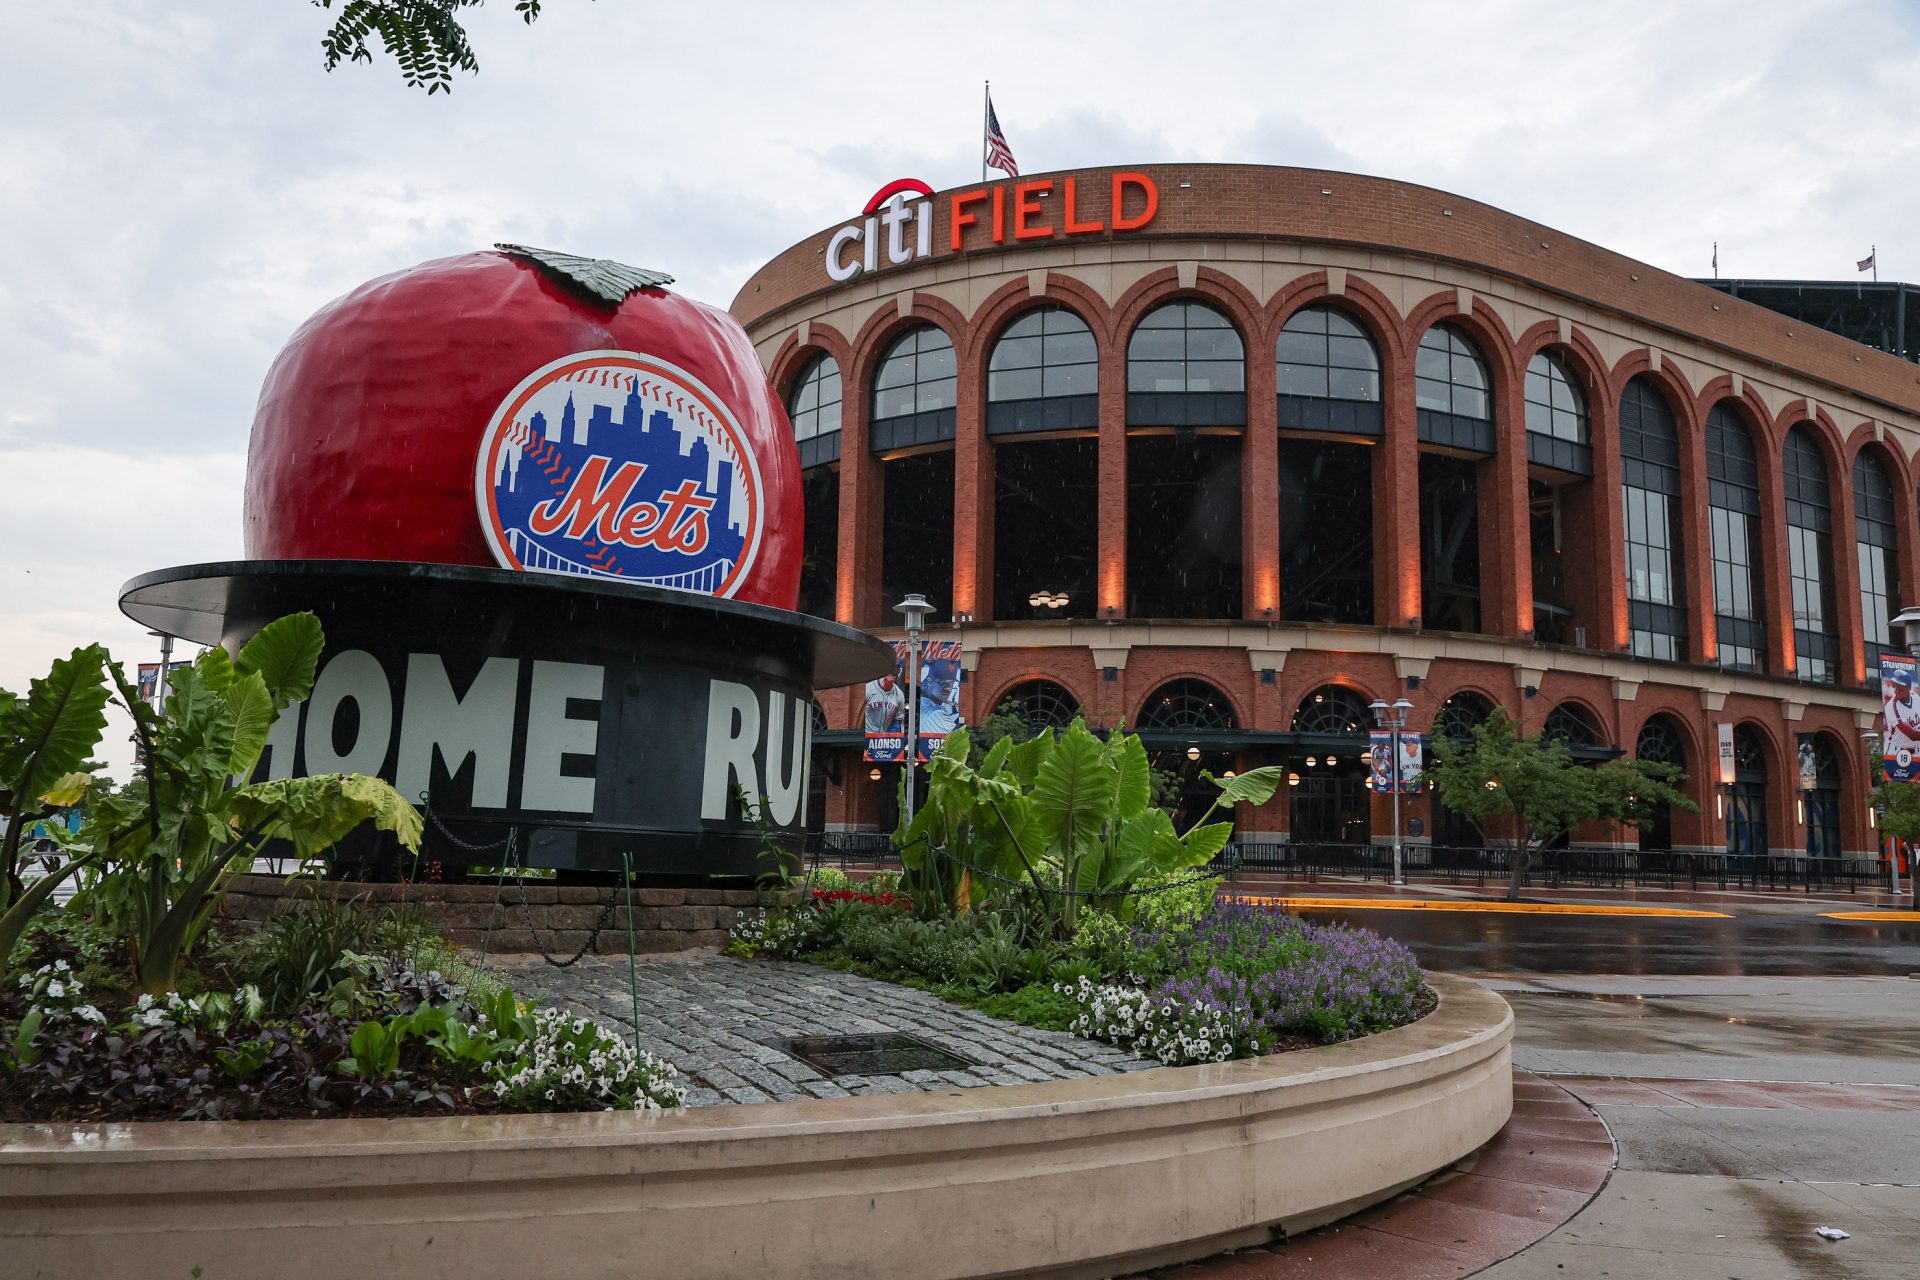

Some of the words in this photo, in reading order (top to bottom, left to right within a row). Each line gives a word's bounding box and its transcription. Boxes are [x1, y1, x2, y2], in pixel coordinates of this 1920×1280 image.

[826, 195, 932, 281] citi
[951, 172, 1159, 251] FIELD
[529, 454, 717, 556] Mets
[868, 738, 902, 749] ALONSO
[874, 750, 893, 759] Ford
[1900, 754, 1908, 763] 18
[1893, 768, 1910, 778] Ford
